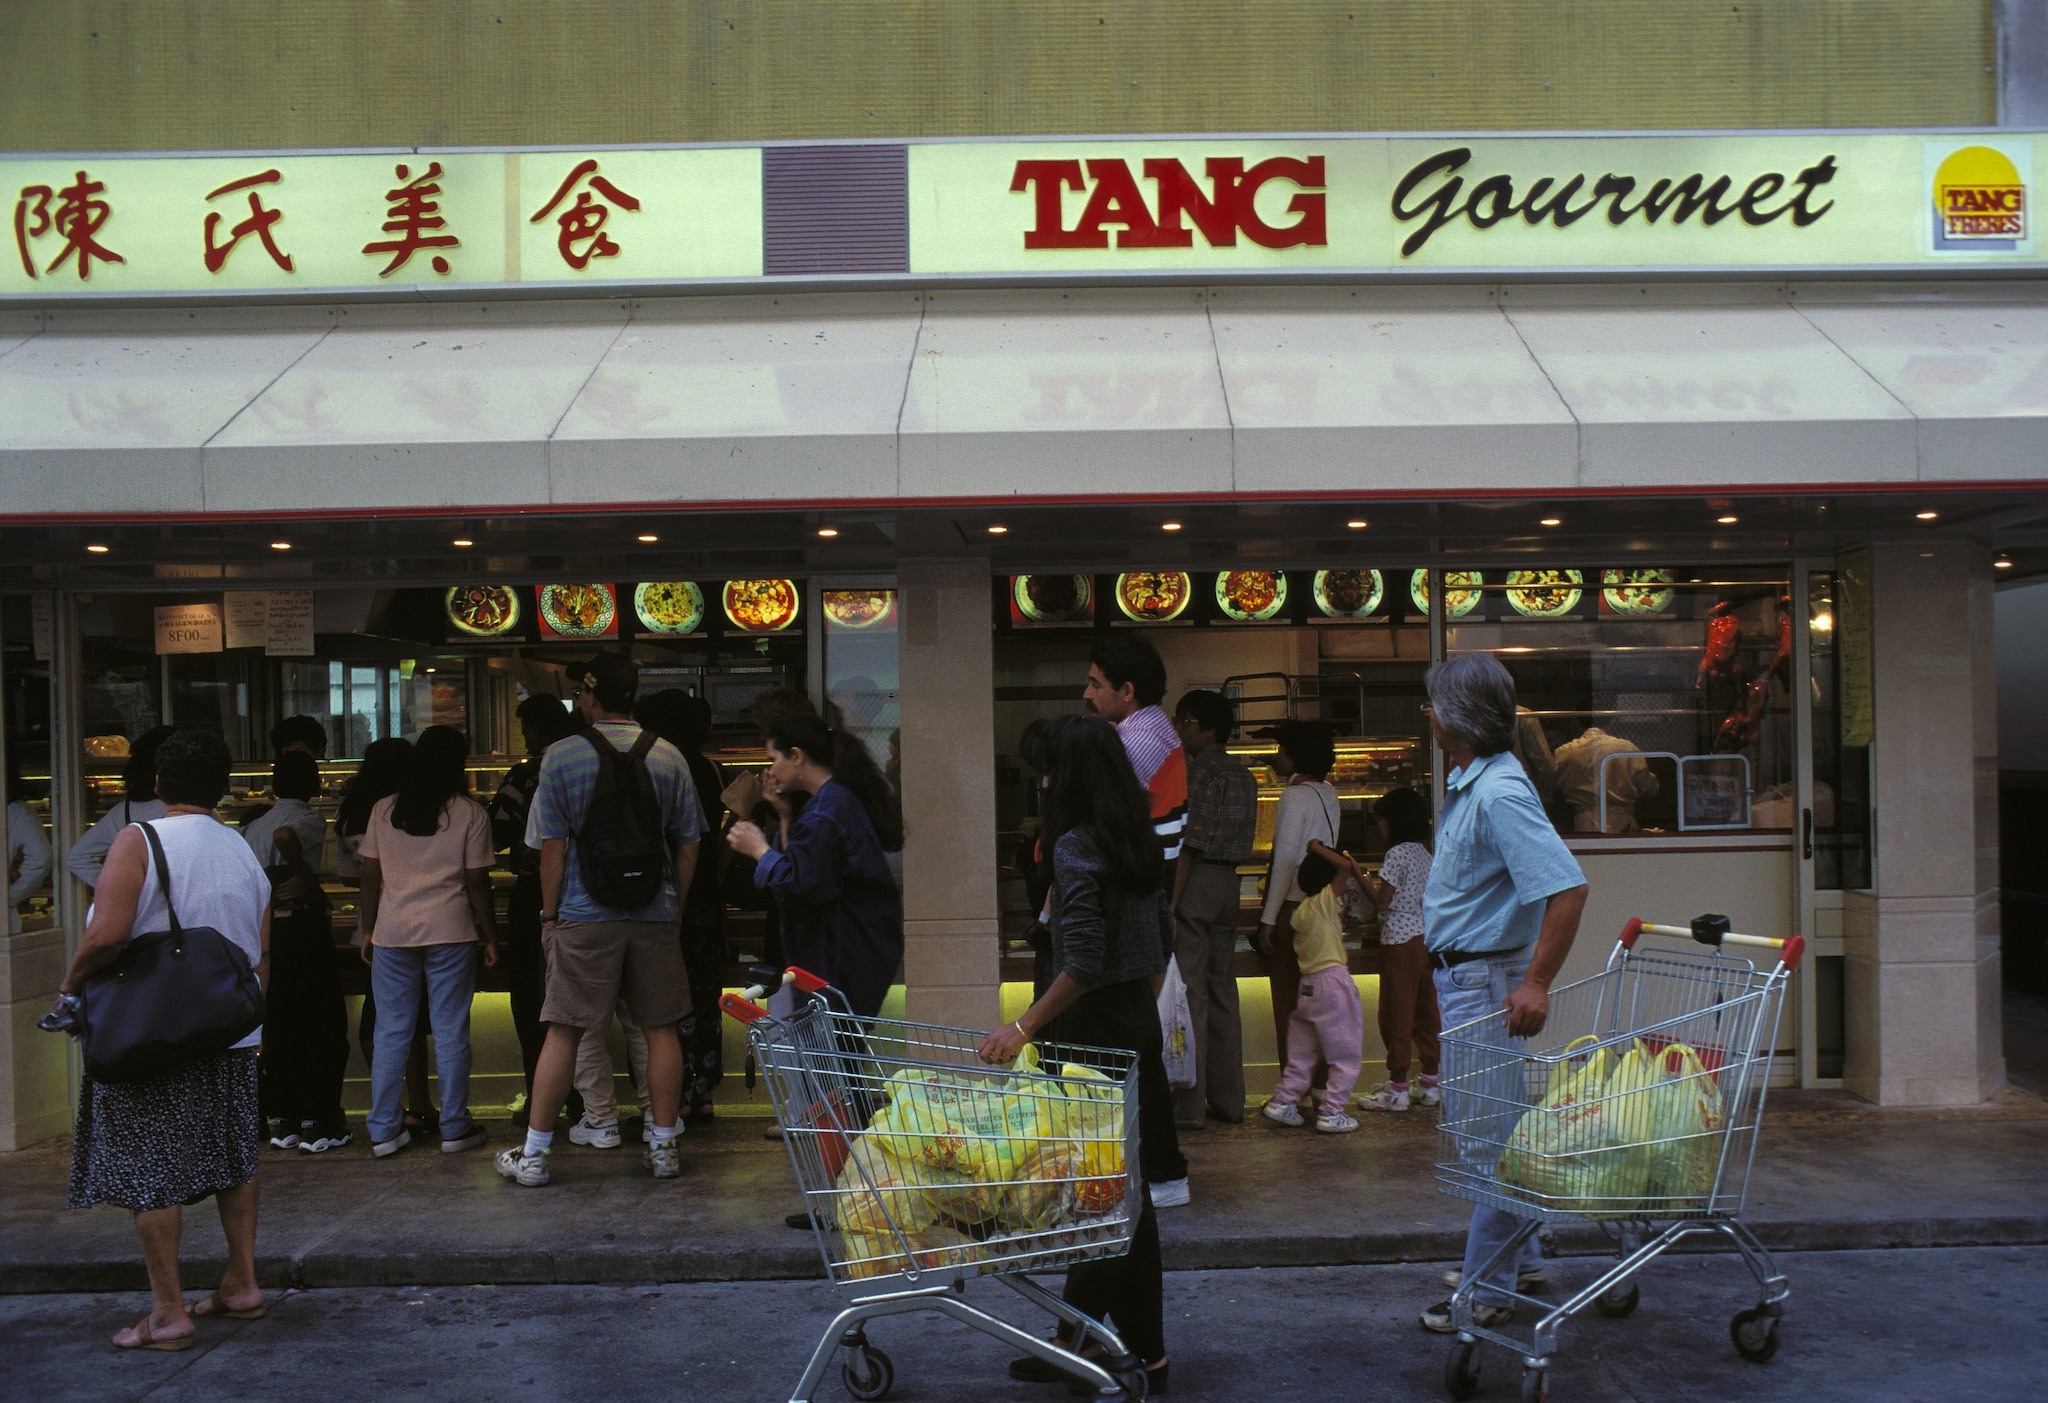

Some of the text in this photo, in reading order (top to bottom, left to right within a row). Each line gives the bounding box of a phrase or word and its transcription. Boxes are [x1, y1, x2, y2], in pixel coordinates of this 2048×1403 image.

[14, 158, 641, 281] 陳氏美食
[1009, 146, 1839, 258] TANG Gourmet
[1946, 189, 2021, 212] TANG
[168, 629, 200, 642] 8F00
